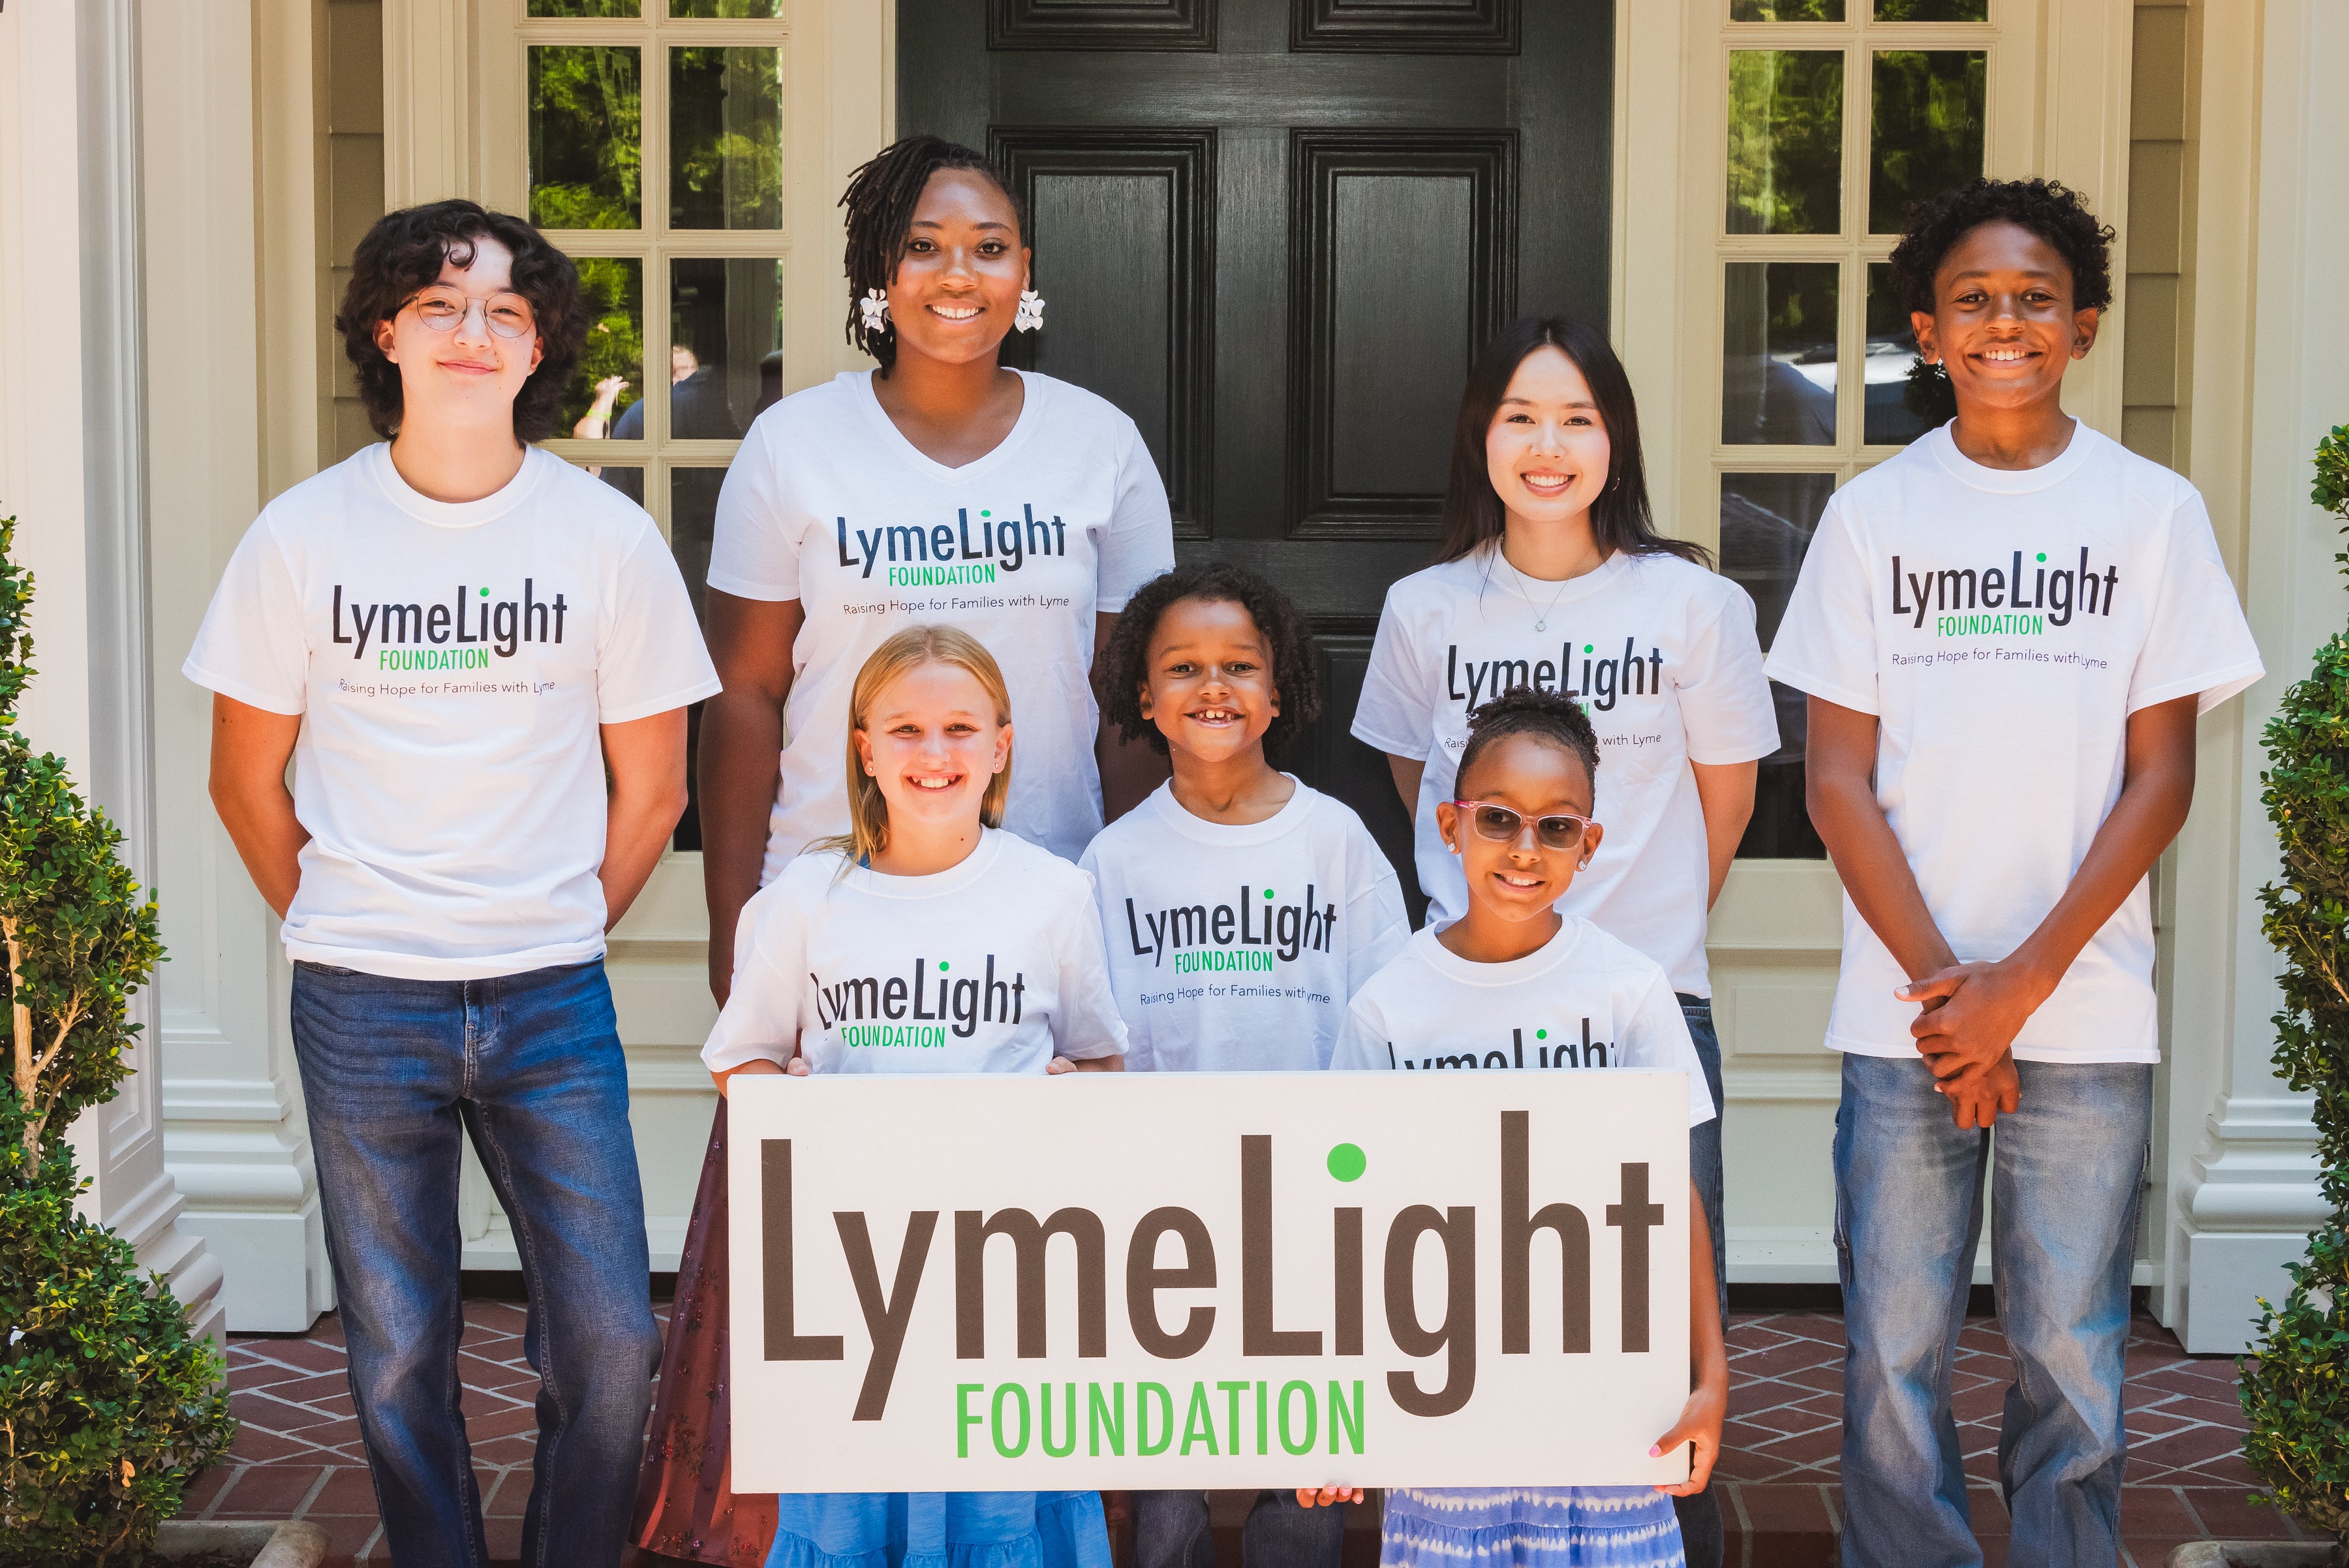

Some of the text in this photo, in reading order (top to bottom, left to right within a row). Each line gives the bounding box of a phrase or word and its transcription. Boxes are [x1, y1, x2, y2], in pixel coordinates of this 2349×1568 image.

[837, 503, 1066, 579] LymeLight
[889, 564, 996, 587] FOUNDATION
[1892, 546, 2119, 628] LymeLight
[843, 594, 1069, 615] Raising Hope for Families with Lyme
[332, 578, 568, 659] LymeLight
[1938, 615, 2043, 638] FOUNDATION
[380, 648, 489, 671] FOUNDATION
[1892, 647, 2108, 669] Raising Hope for Families with Lyme
[1447, 637, 1663, 714] LymeLight
[338, 678, 555, 698] Raising Hope for Families with Lyme
[1444, 734, 1662, 748] Raisi with Lyme
[1125, 884, 1337, 968] LymeLight
[1174, 951, 1273, 974] FOUNDATION
[1140, 983, 1331, 1006] Raising Hope for Families with yme
[841, 1025, 945, 1048] FOUNDATION
[761, 1111, 1665, 1422] LymeLight
[956, 1380, 1366, 1459] FOUNDATION
